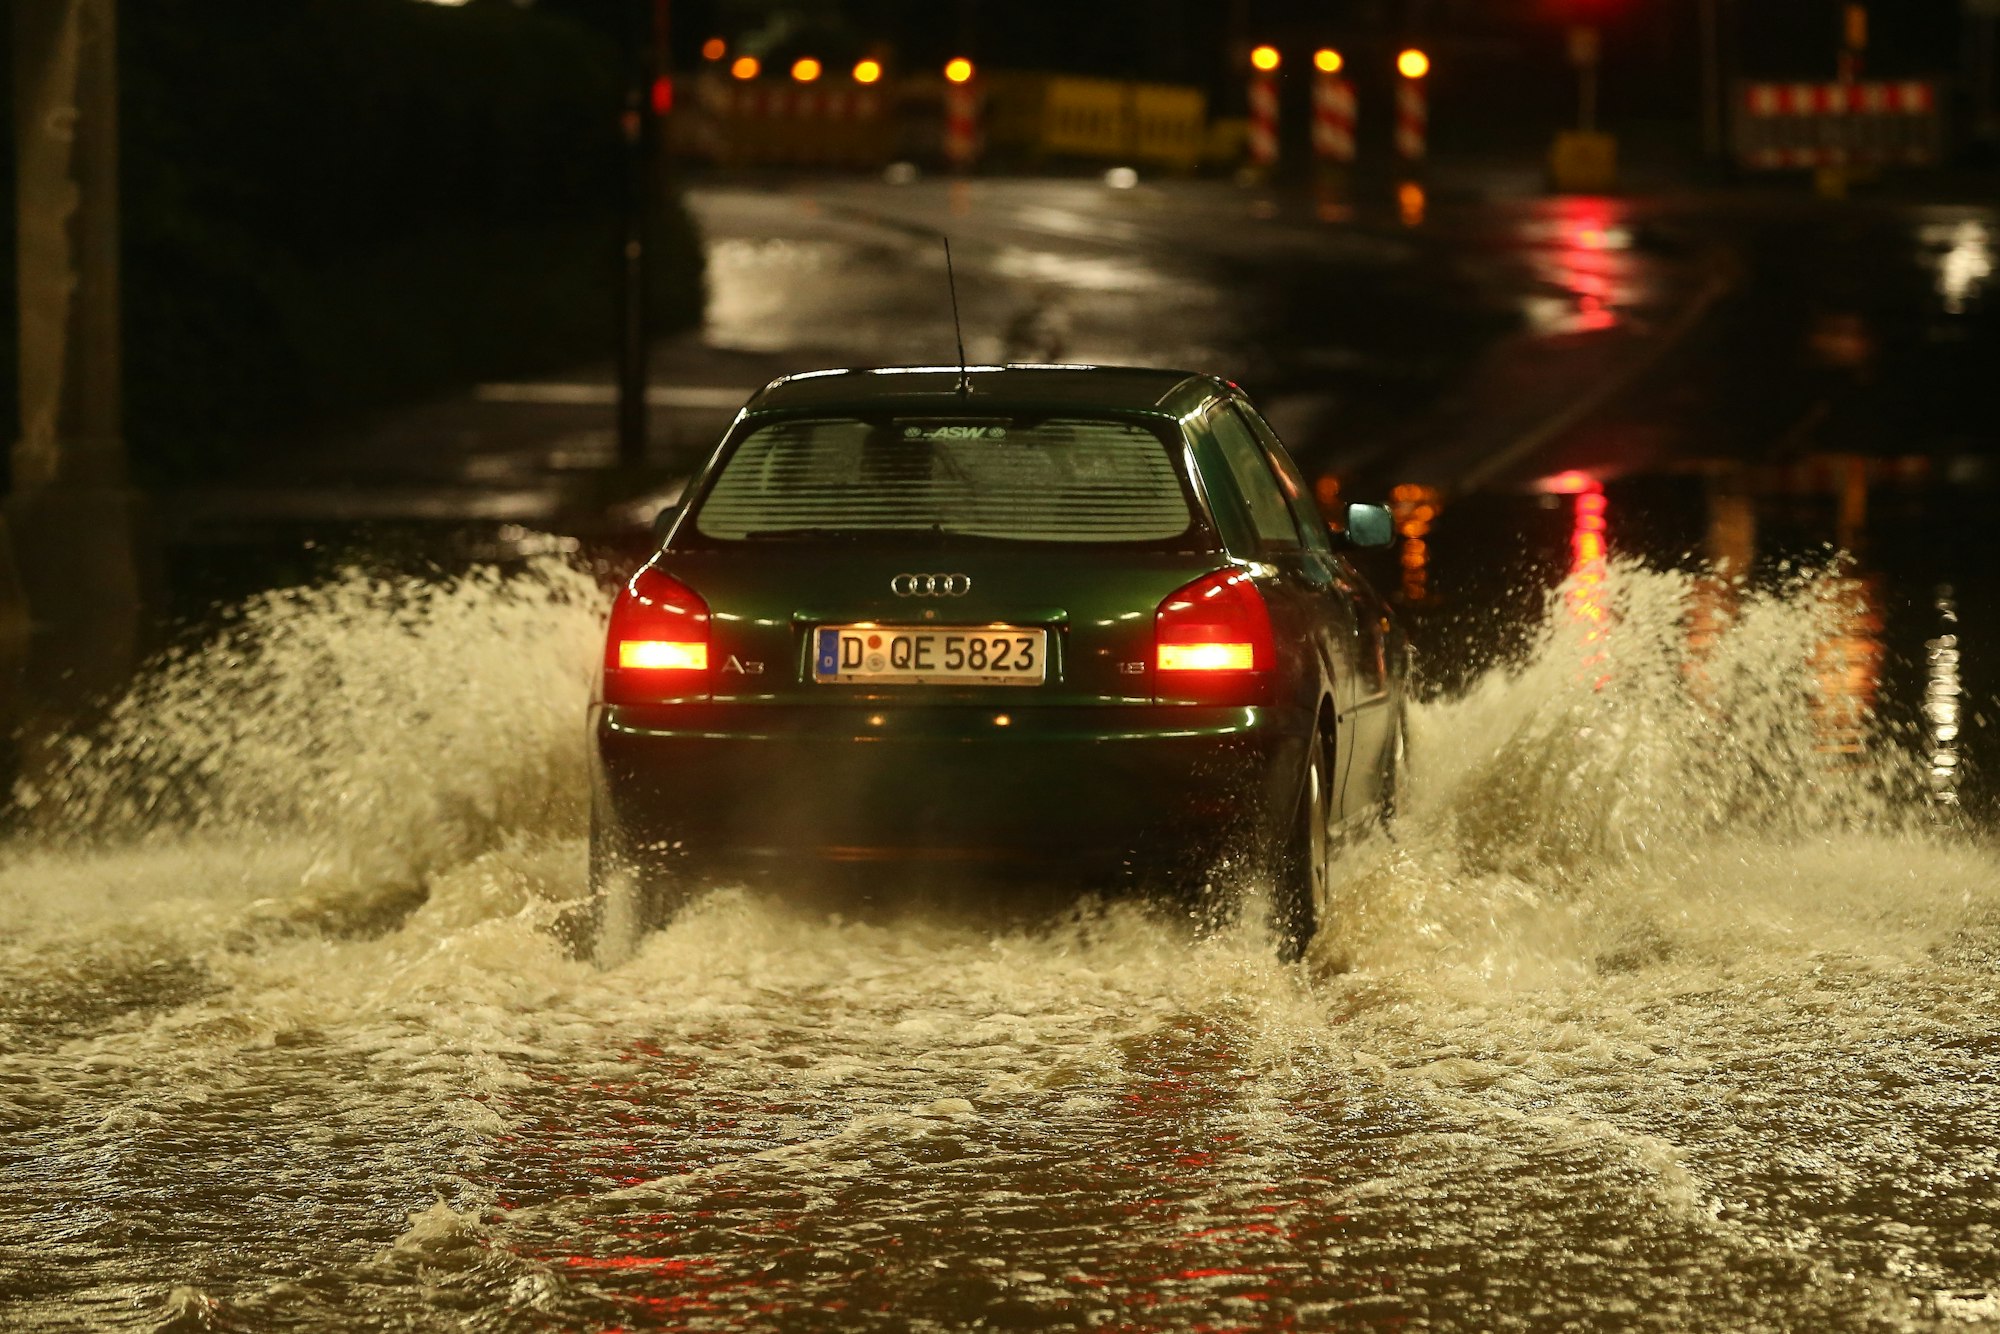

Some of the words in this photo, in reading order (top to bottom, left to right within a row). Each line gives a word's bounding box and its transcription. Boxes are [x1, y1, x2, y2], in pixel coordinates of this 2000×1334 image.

[842, 636, 863, 669] D
[890, 636, 934, 670] QE
[945, 637, 1034, 671] 5823
